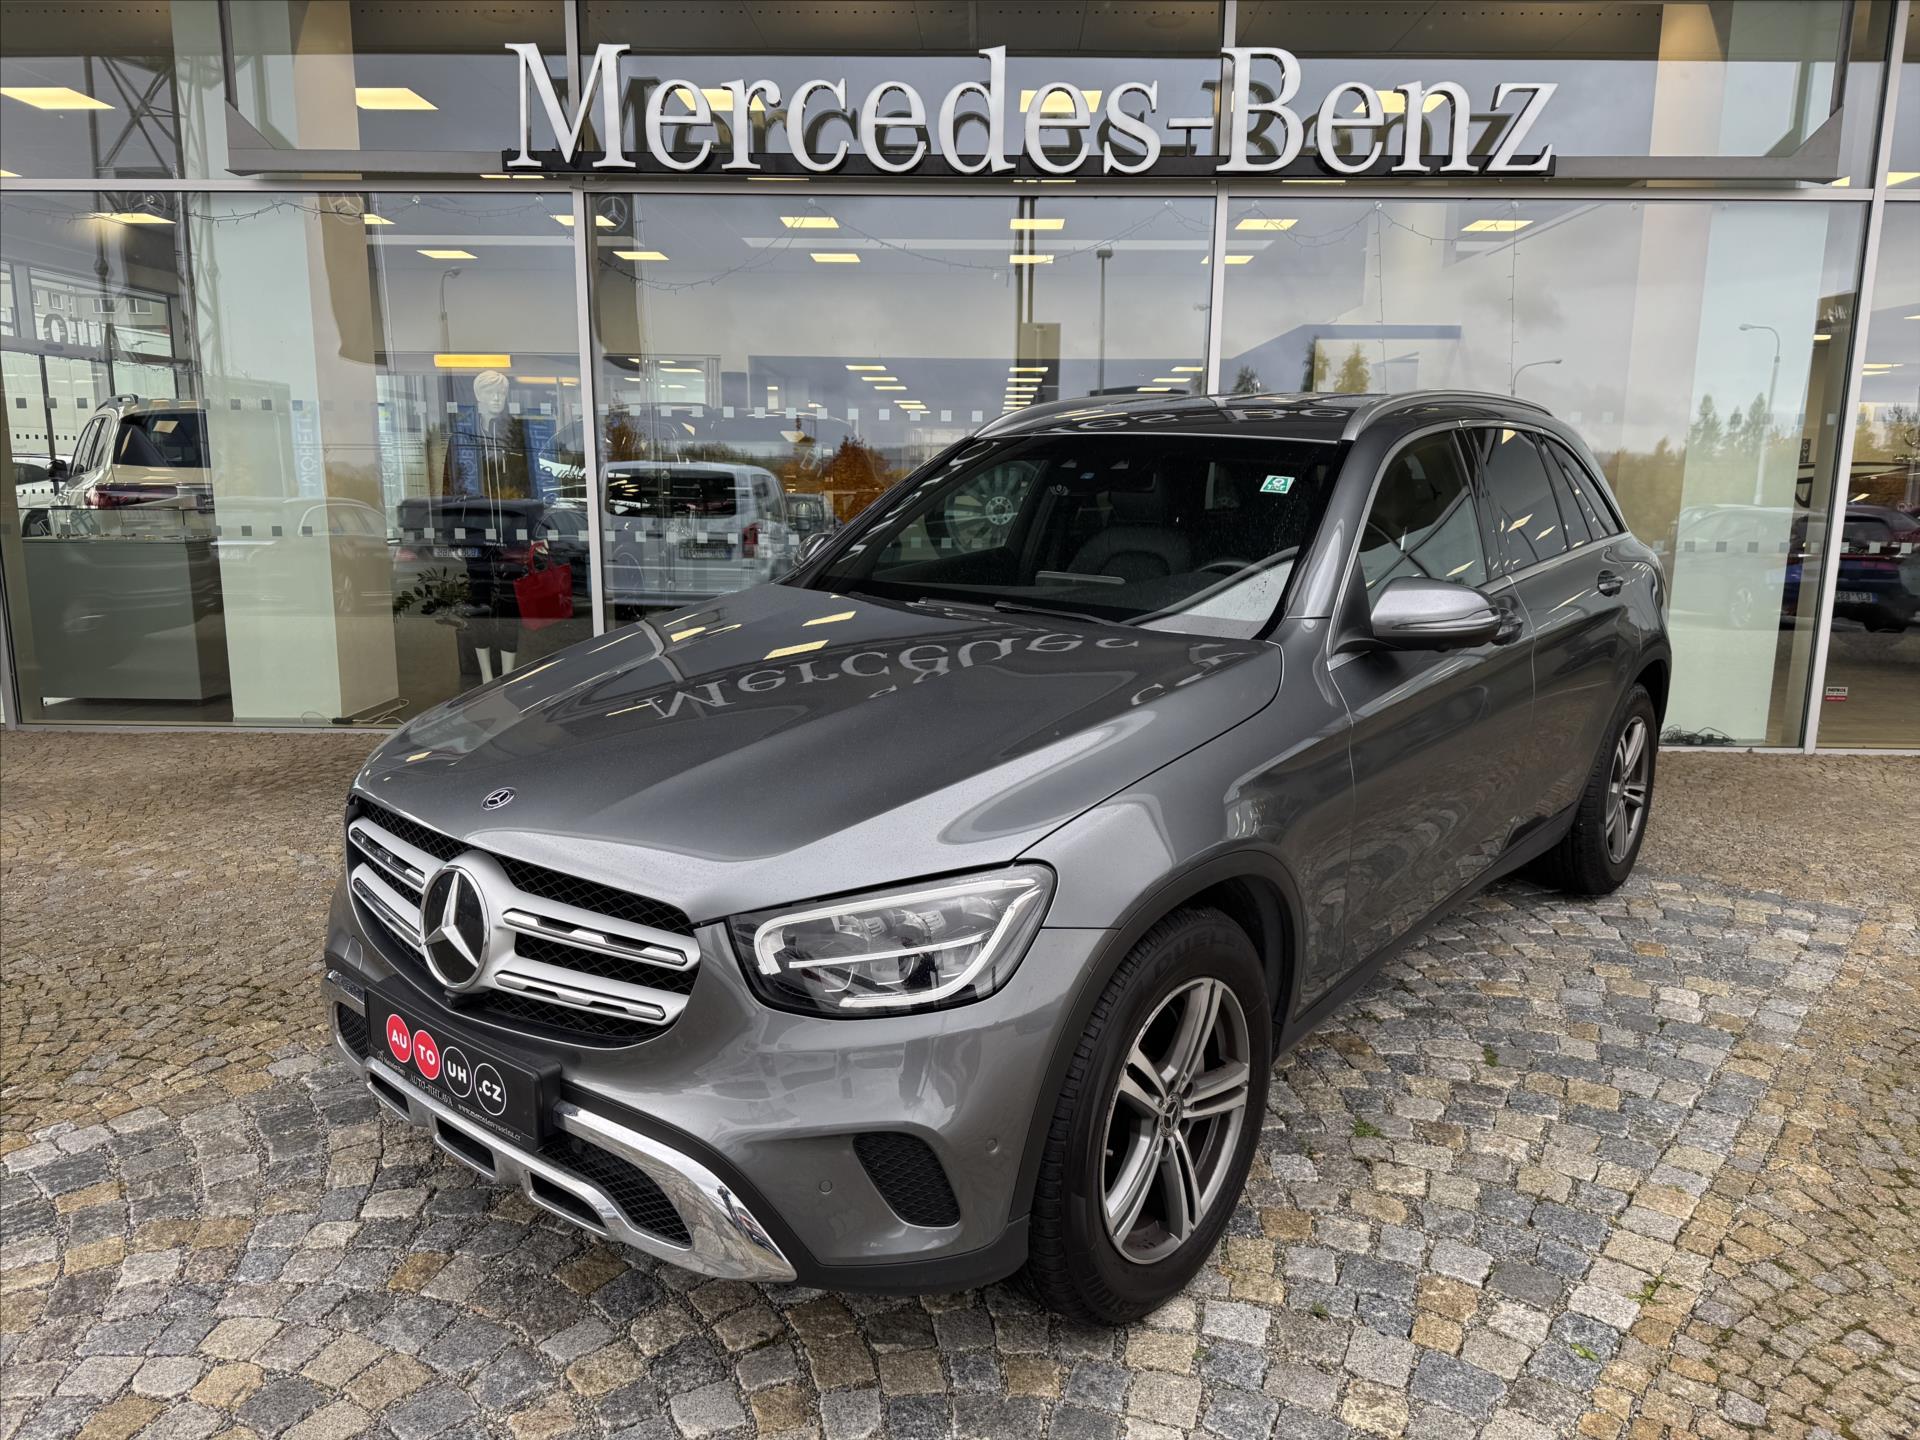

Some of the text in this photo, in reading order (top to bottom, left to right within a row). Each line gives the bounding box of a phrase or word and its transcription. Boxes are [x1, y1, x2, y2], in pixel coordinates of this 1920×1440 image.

[504, 42, 1559, 174] Mercedes-Benz
[392, 1029, 407, 1049] AU
[418, 1044, 435, 1065] TO
[447, 1061, 467, 1084] UH
